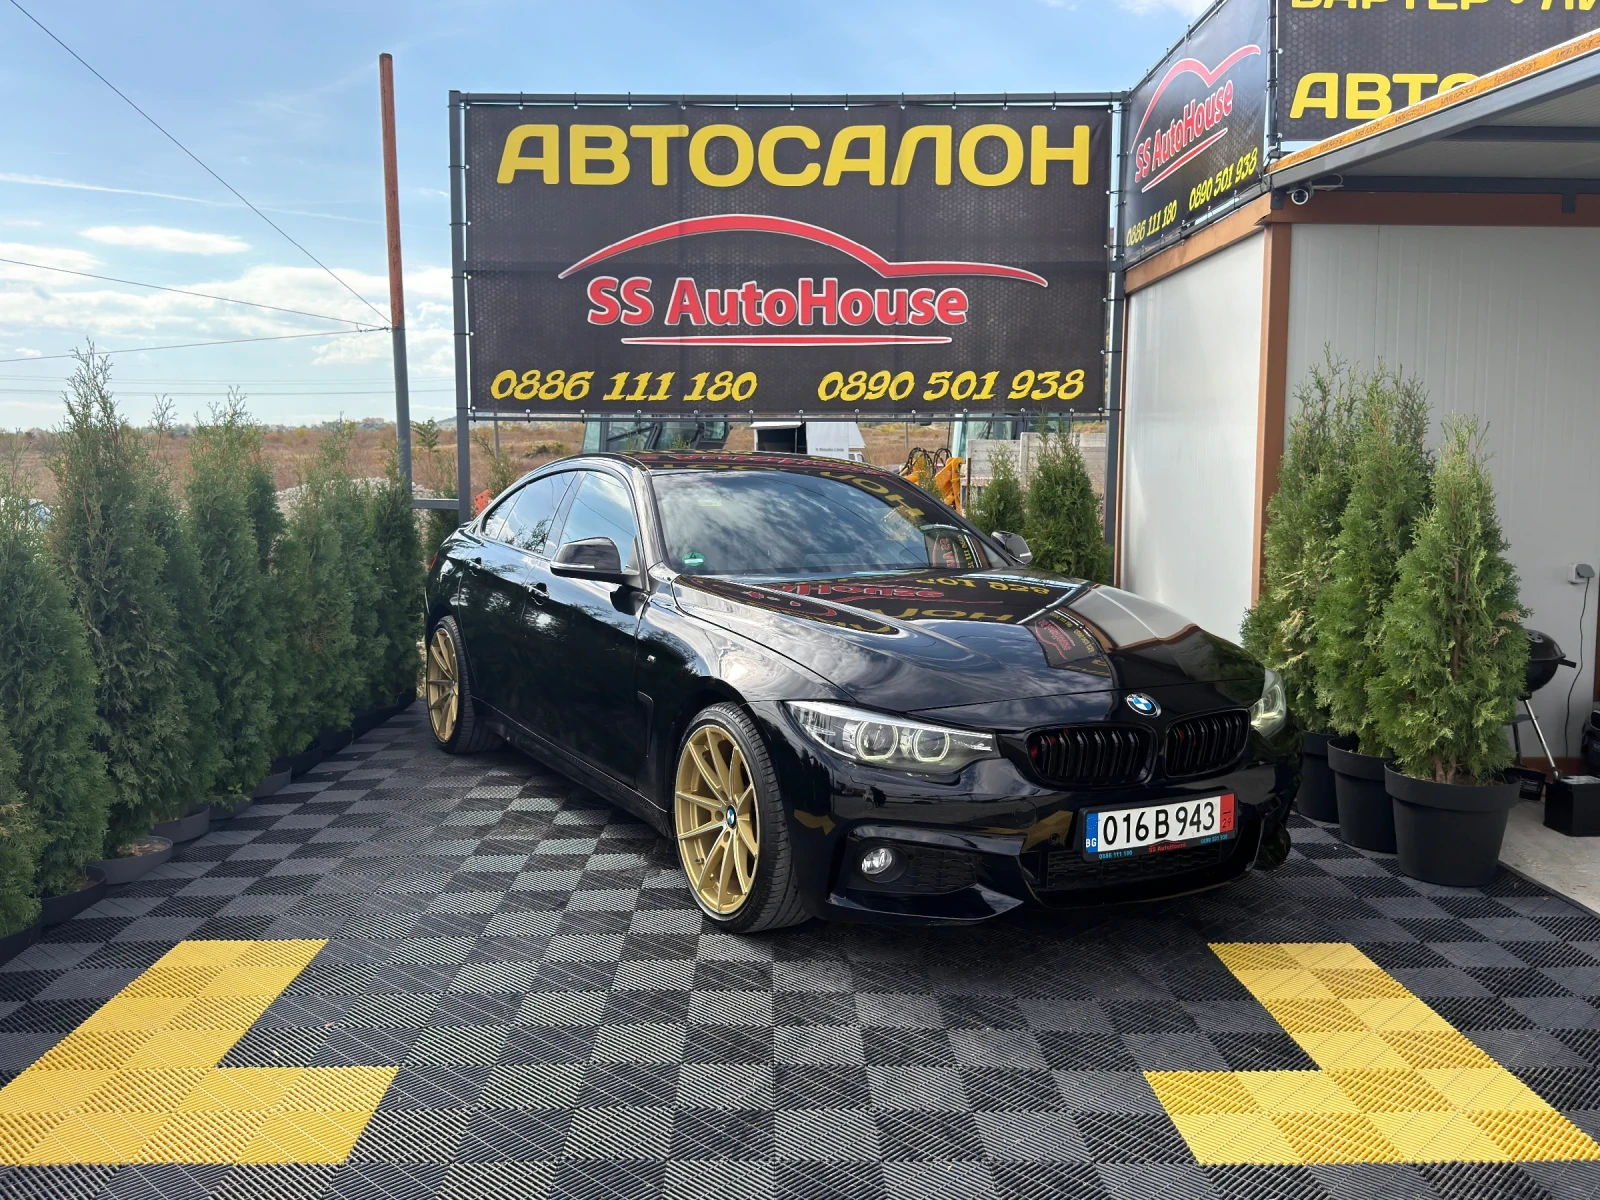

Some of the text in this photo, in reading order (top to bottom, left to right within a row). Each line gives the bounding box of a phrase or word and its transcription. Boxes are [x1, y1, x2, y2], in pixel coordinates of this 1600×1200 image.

[497, 123, 1090, 187] АВТОСАЛОН
[1134, 79, 1233, 183] SS AutoHouse
[1126, 147, 1258, 248] 0886 111 180 0890 501 938
[587, 276, 969, 327] SS AutoHouse
[490, 368, 1085, 401] 0886 111 180 0890 501 938
[1085, 837, 1097, 848] BG
